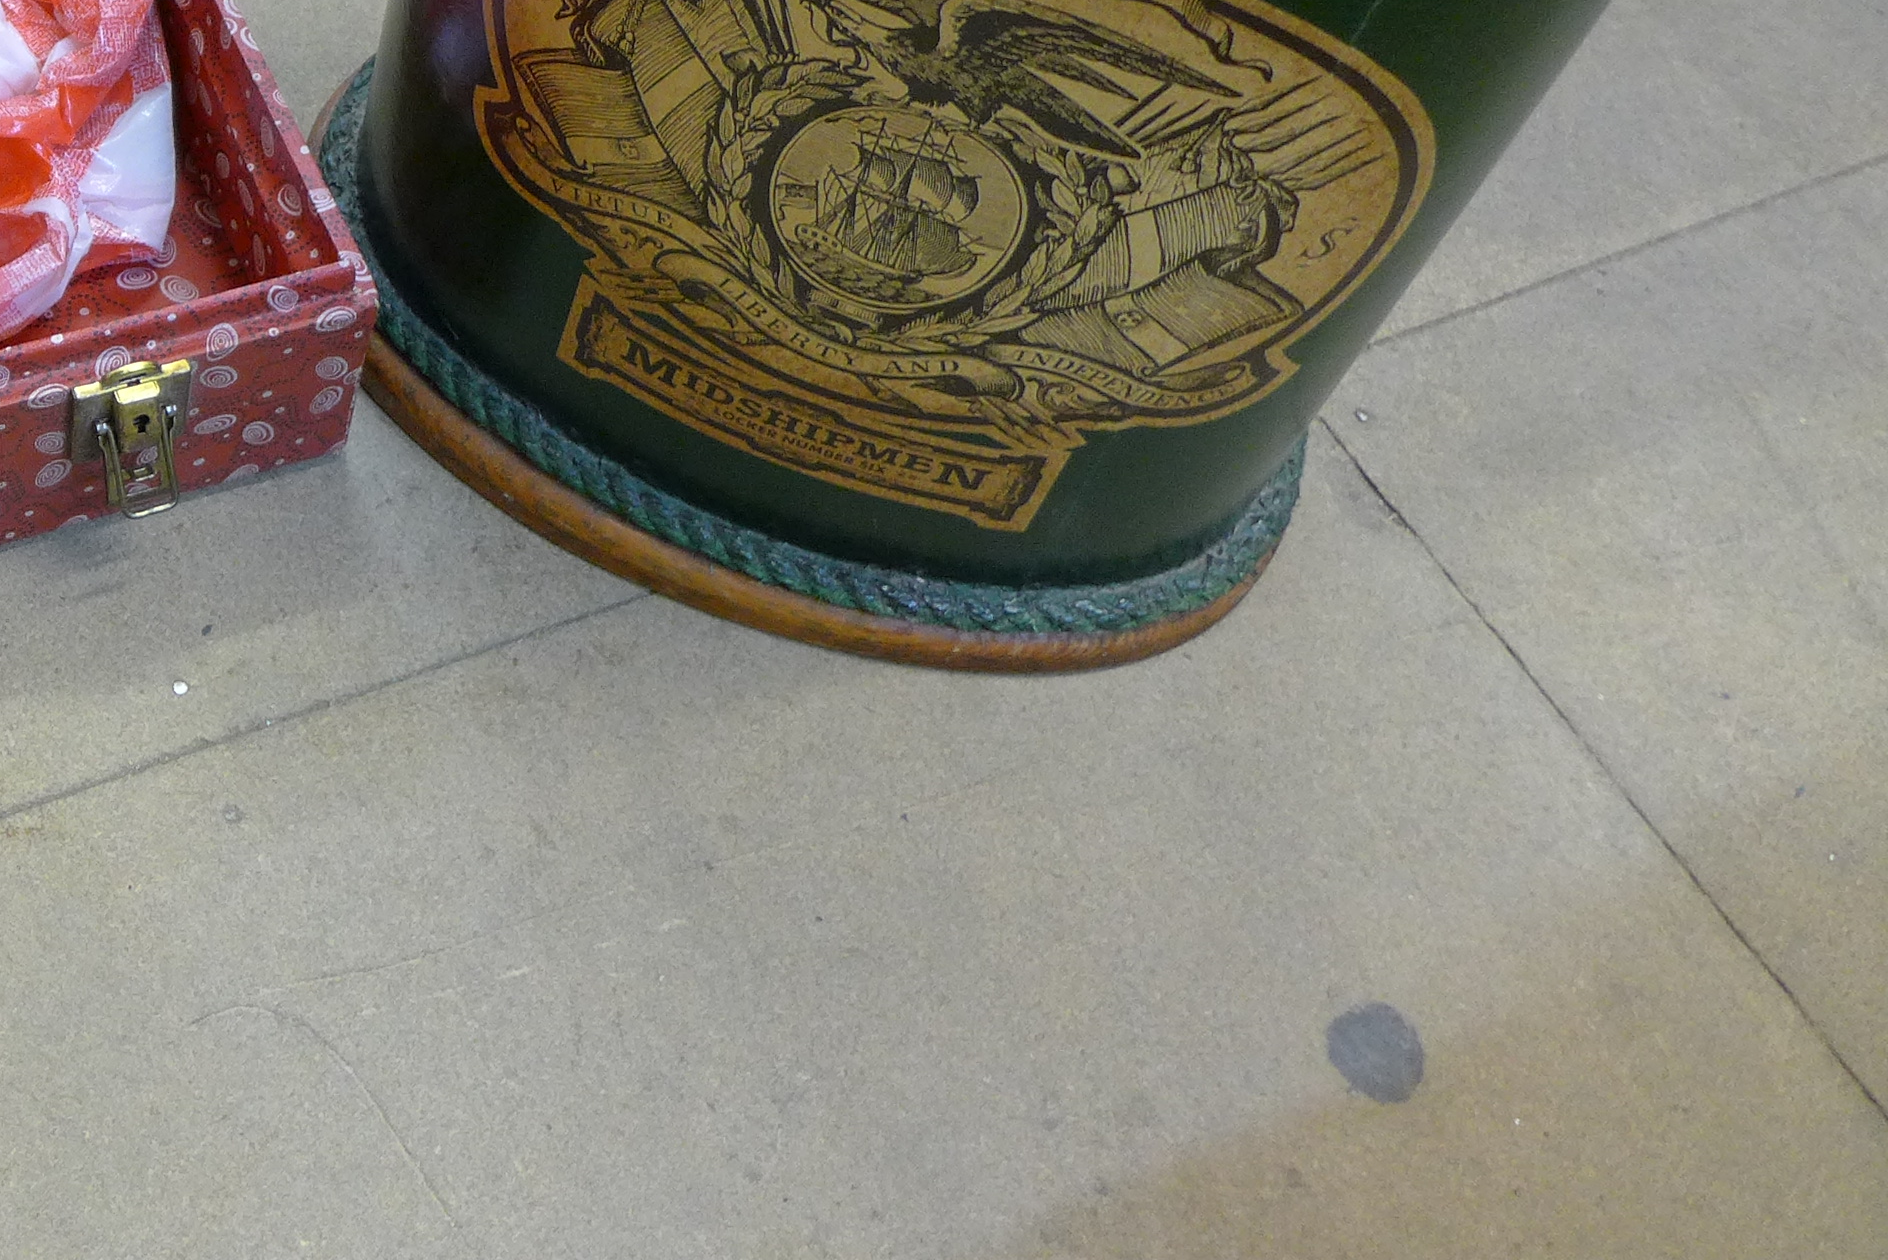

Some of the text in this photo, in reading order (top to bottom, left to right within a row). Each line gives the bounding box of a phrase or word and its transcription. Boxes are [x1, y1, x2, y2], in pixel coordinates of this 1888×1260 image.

[550, 177, 1236, 408] VIRTUE LIBERTY AND INDEPENDENCE
[622, 336, 994, 491] MIDSHIPMEN
[713, 407, 886, 475] LOCKER NUMBER SIX
